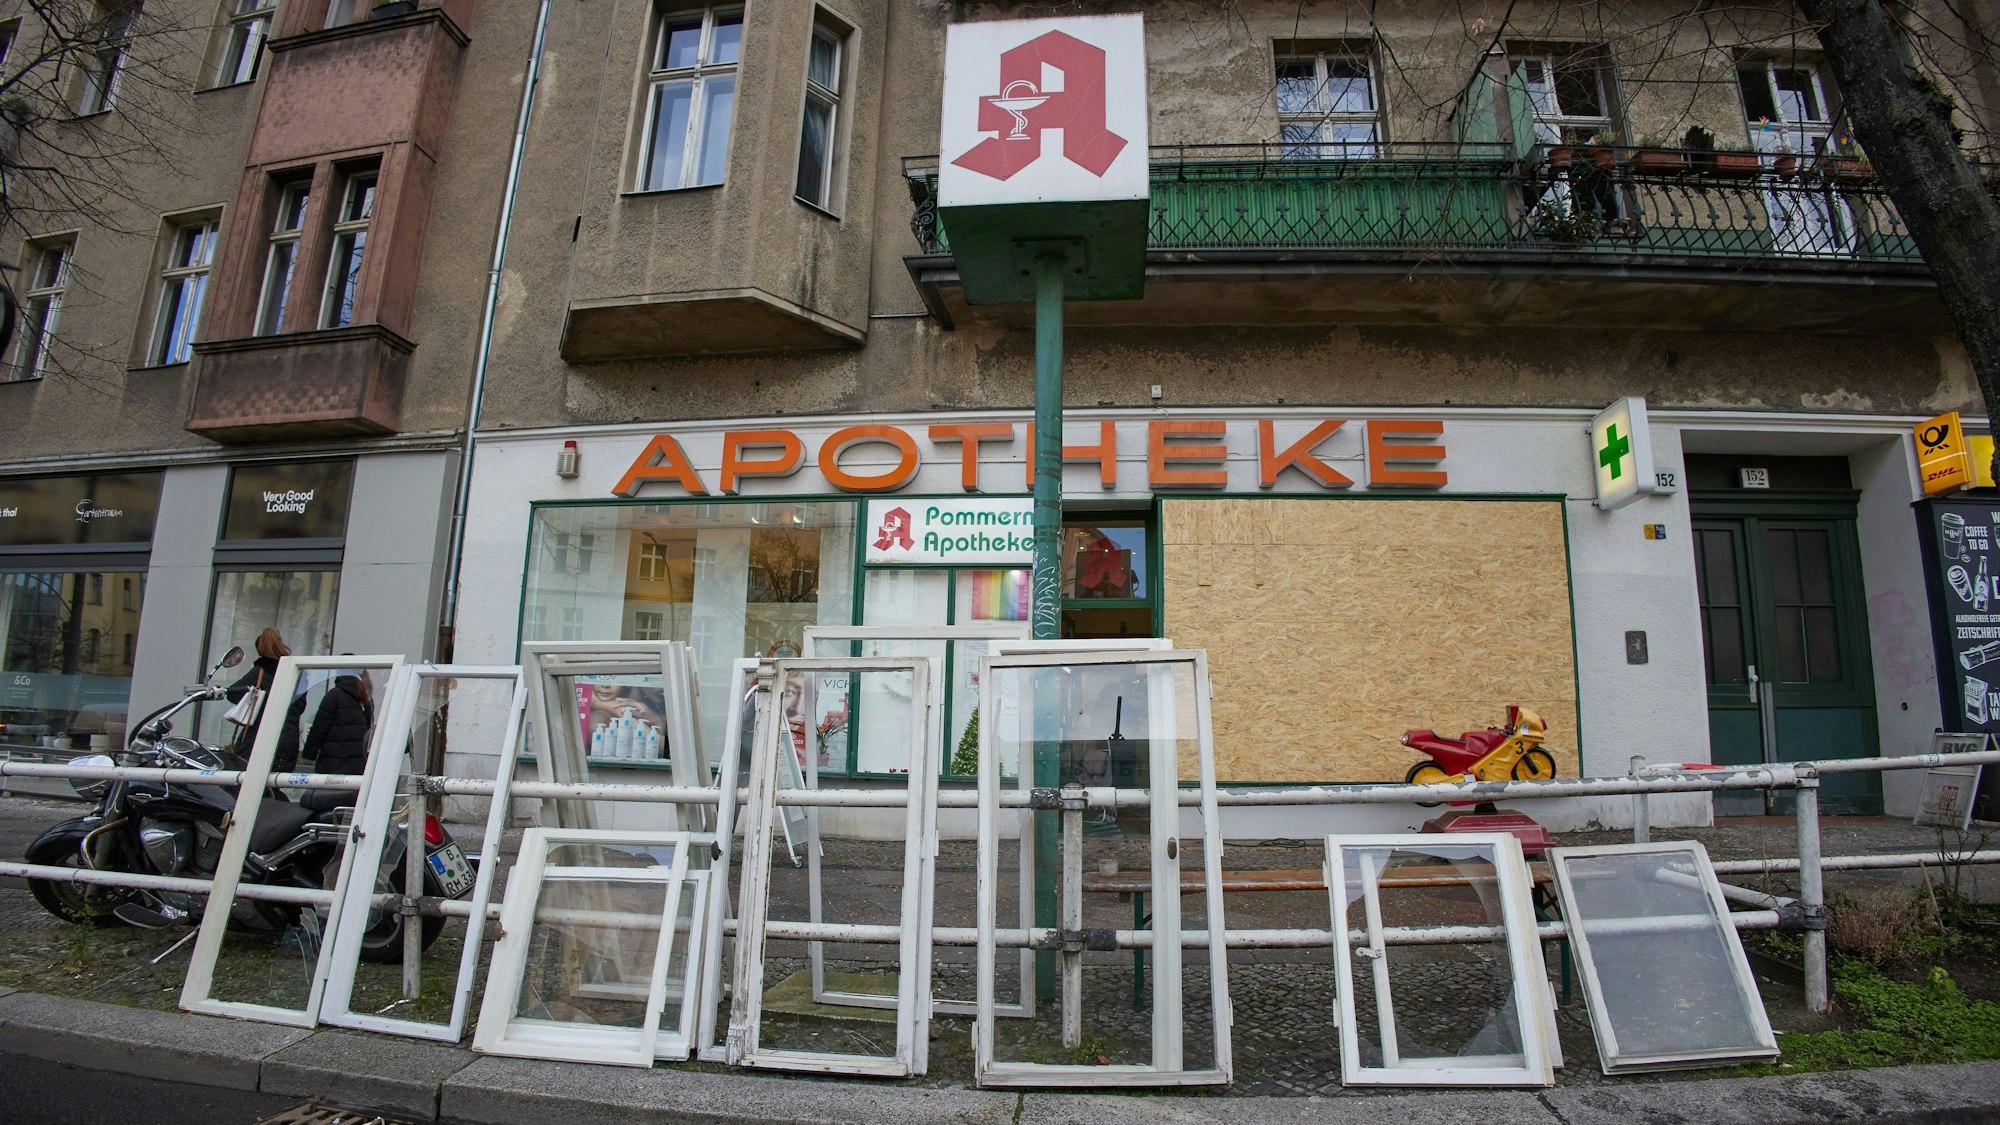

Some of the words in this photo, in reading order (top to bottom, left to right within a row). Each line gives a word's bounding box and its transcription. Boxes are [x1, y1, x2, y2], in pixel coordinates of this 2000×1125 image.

[611, 420, 1447, 497] APOTHEKE
[1655, 473, 1675, 487] 152
[1745, 470, 1765, 482] 152
[1927, 467, 1957, 481] DHL
[263, 491, 285, 504] Very
[286, 489, 314, 501] Good
[266, 500, 306, 514] Looking
[925, 506, 1034, 526] Pommern
[1964, 526, 1988, 538] COFFEE
[924, 531, 1034, 557] Apotheke
[1967, 539, 1977, 550] TO
[1978, 539, 1988, 550] GO
[1515, 741, 1524, 755] 3
[445, 849, 455, 861] B
[446, 878, 463, 896] RM
[461, 871, 474, 885] 33
